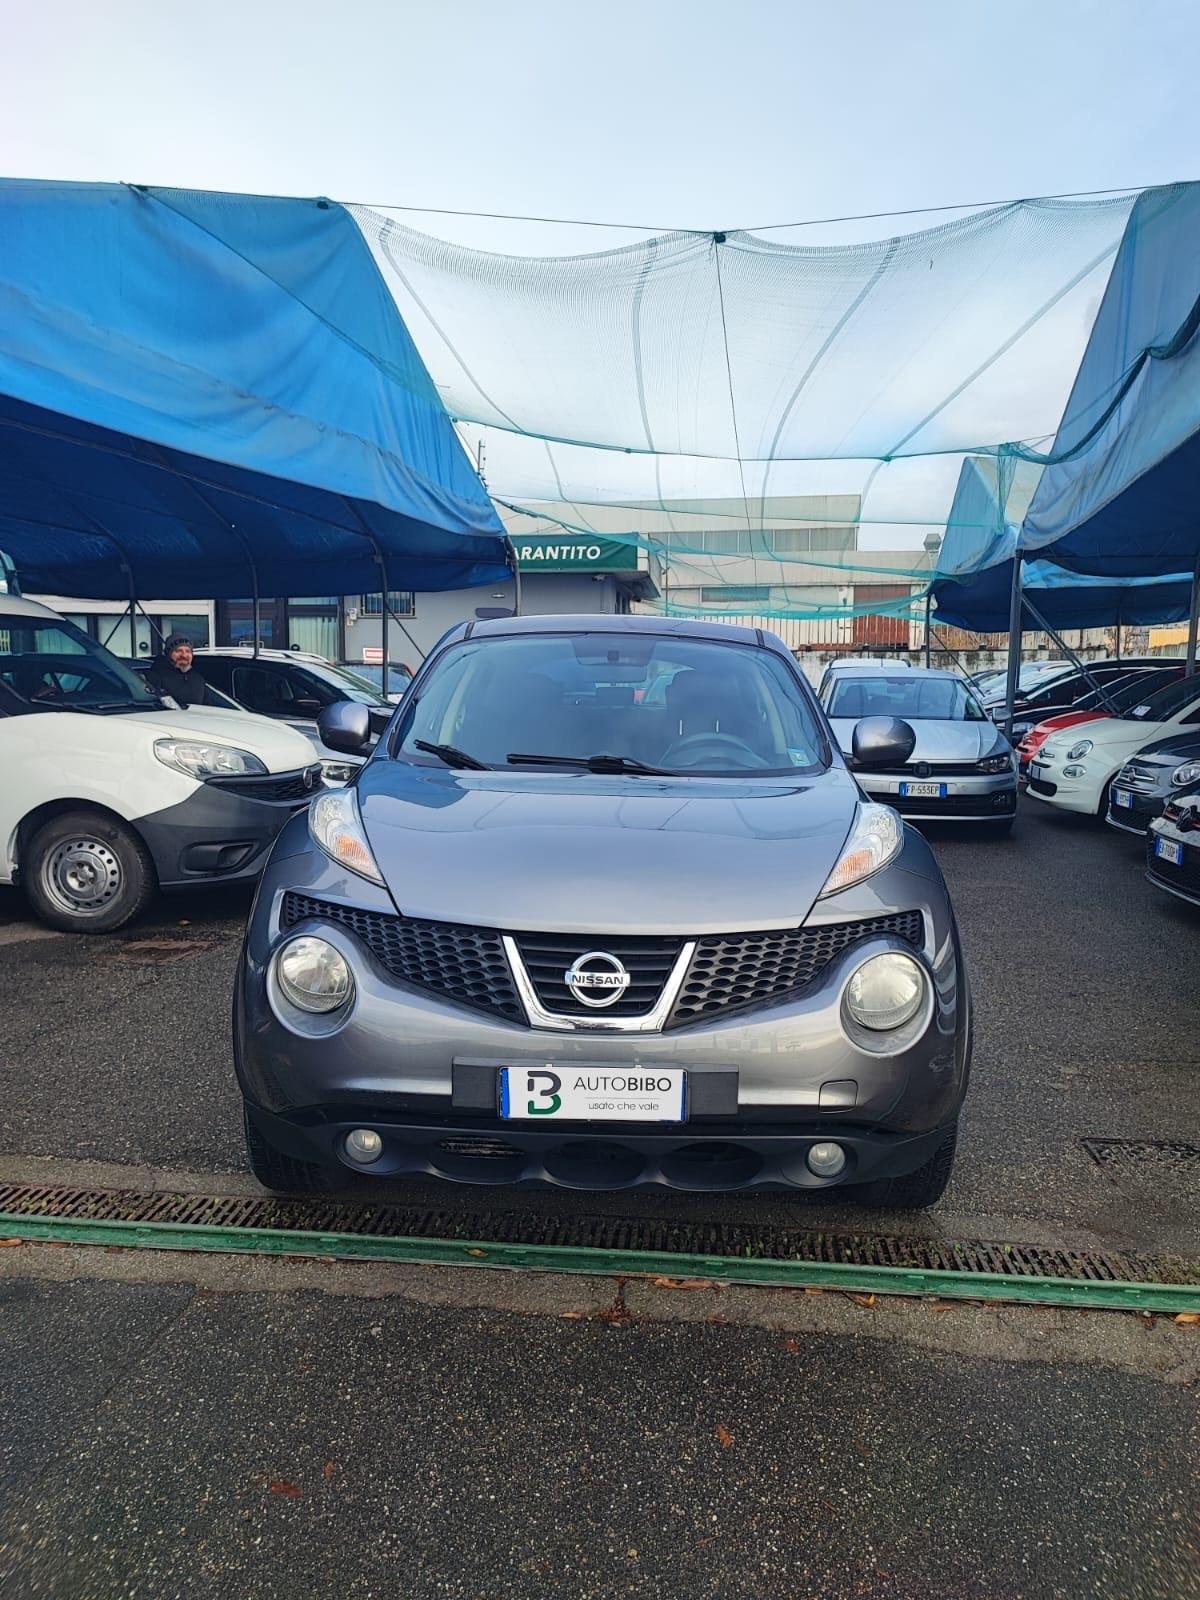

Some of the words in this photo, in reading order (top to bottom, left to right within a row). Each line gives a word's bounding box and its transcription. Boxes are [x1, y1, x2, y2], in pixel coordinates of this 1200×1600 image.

[572, 974, 624, 985] NISSAN
[573, 1076, 672, 1092] AUTOBIBO
[588, 1101, 615, 1110] usato
[617, 1101, 636, 1110] che
[638, 1102, 660, 1111] vale
